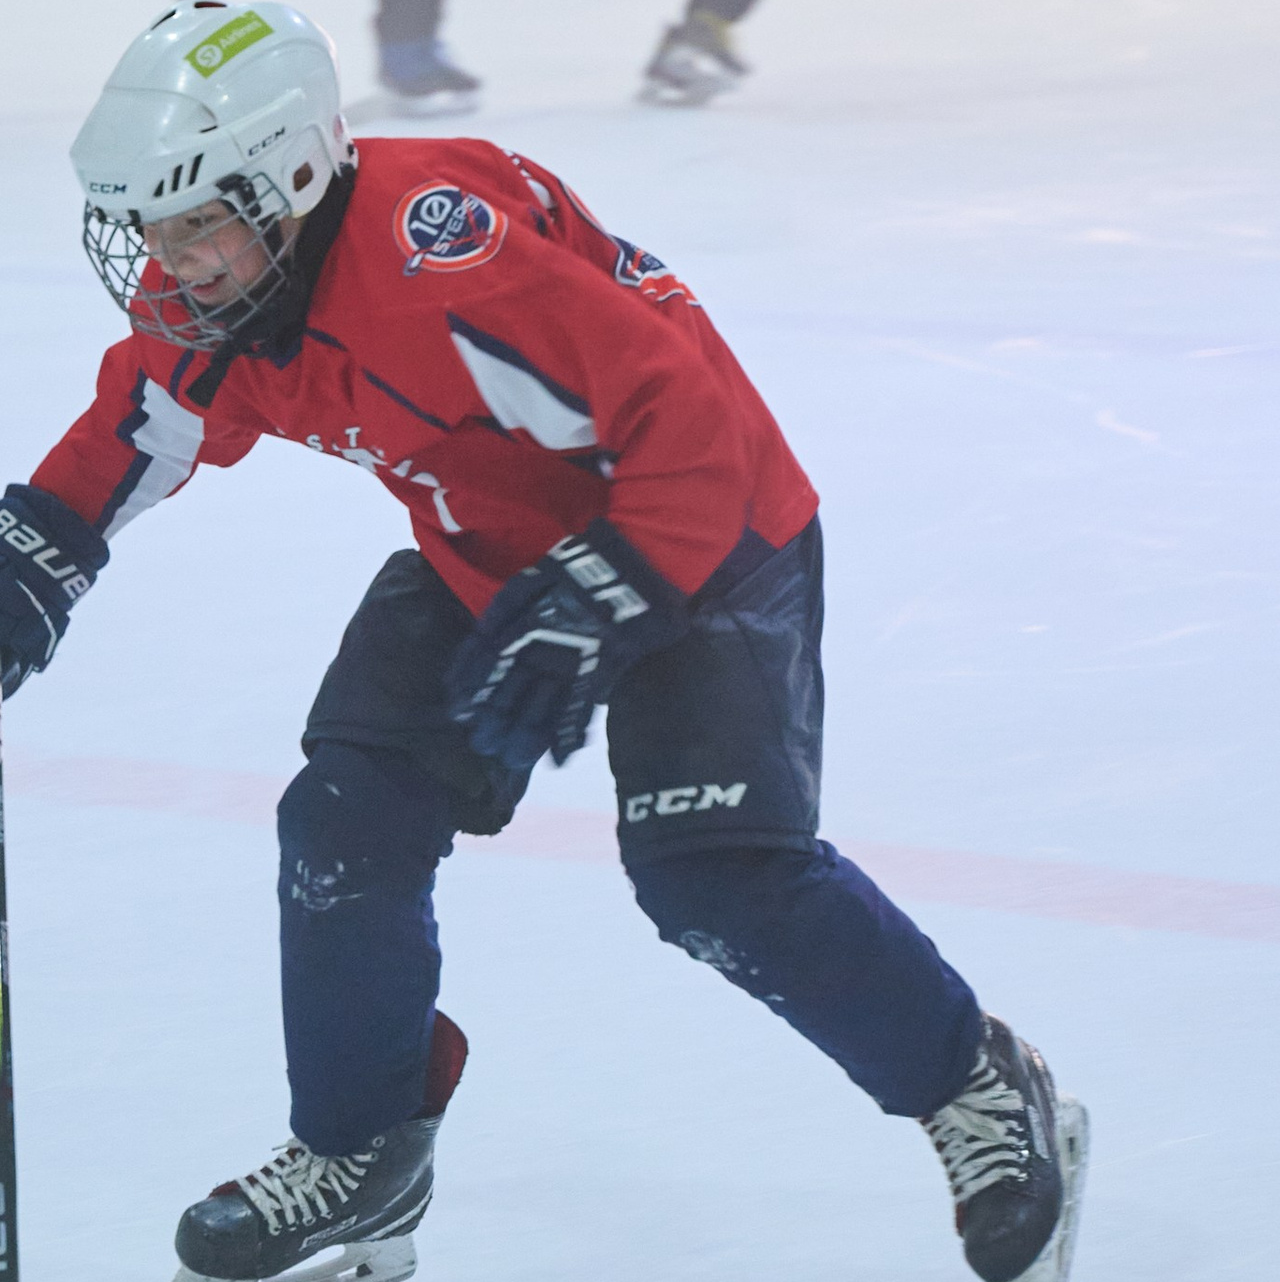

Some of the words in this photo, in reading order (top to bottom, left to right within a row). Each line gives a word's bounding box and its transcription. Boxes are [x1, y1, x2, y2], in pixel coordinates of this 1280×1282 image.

[248, 126, 287, 157] CCM
[89, 181, 128, 195] CCM
[409, 194, 454, 237] 10
[626, 782, 748, 824] CCM
